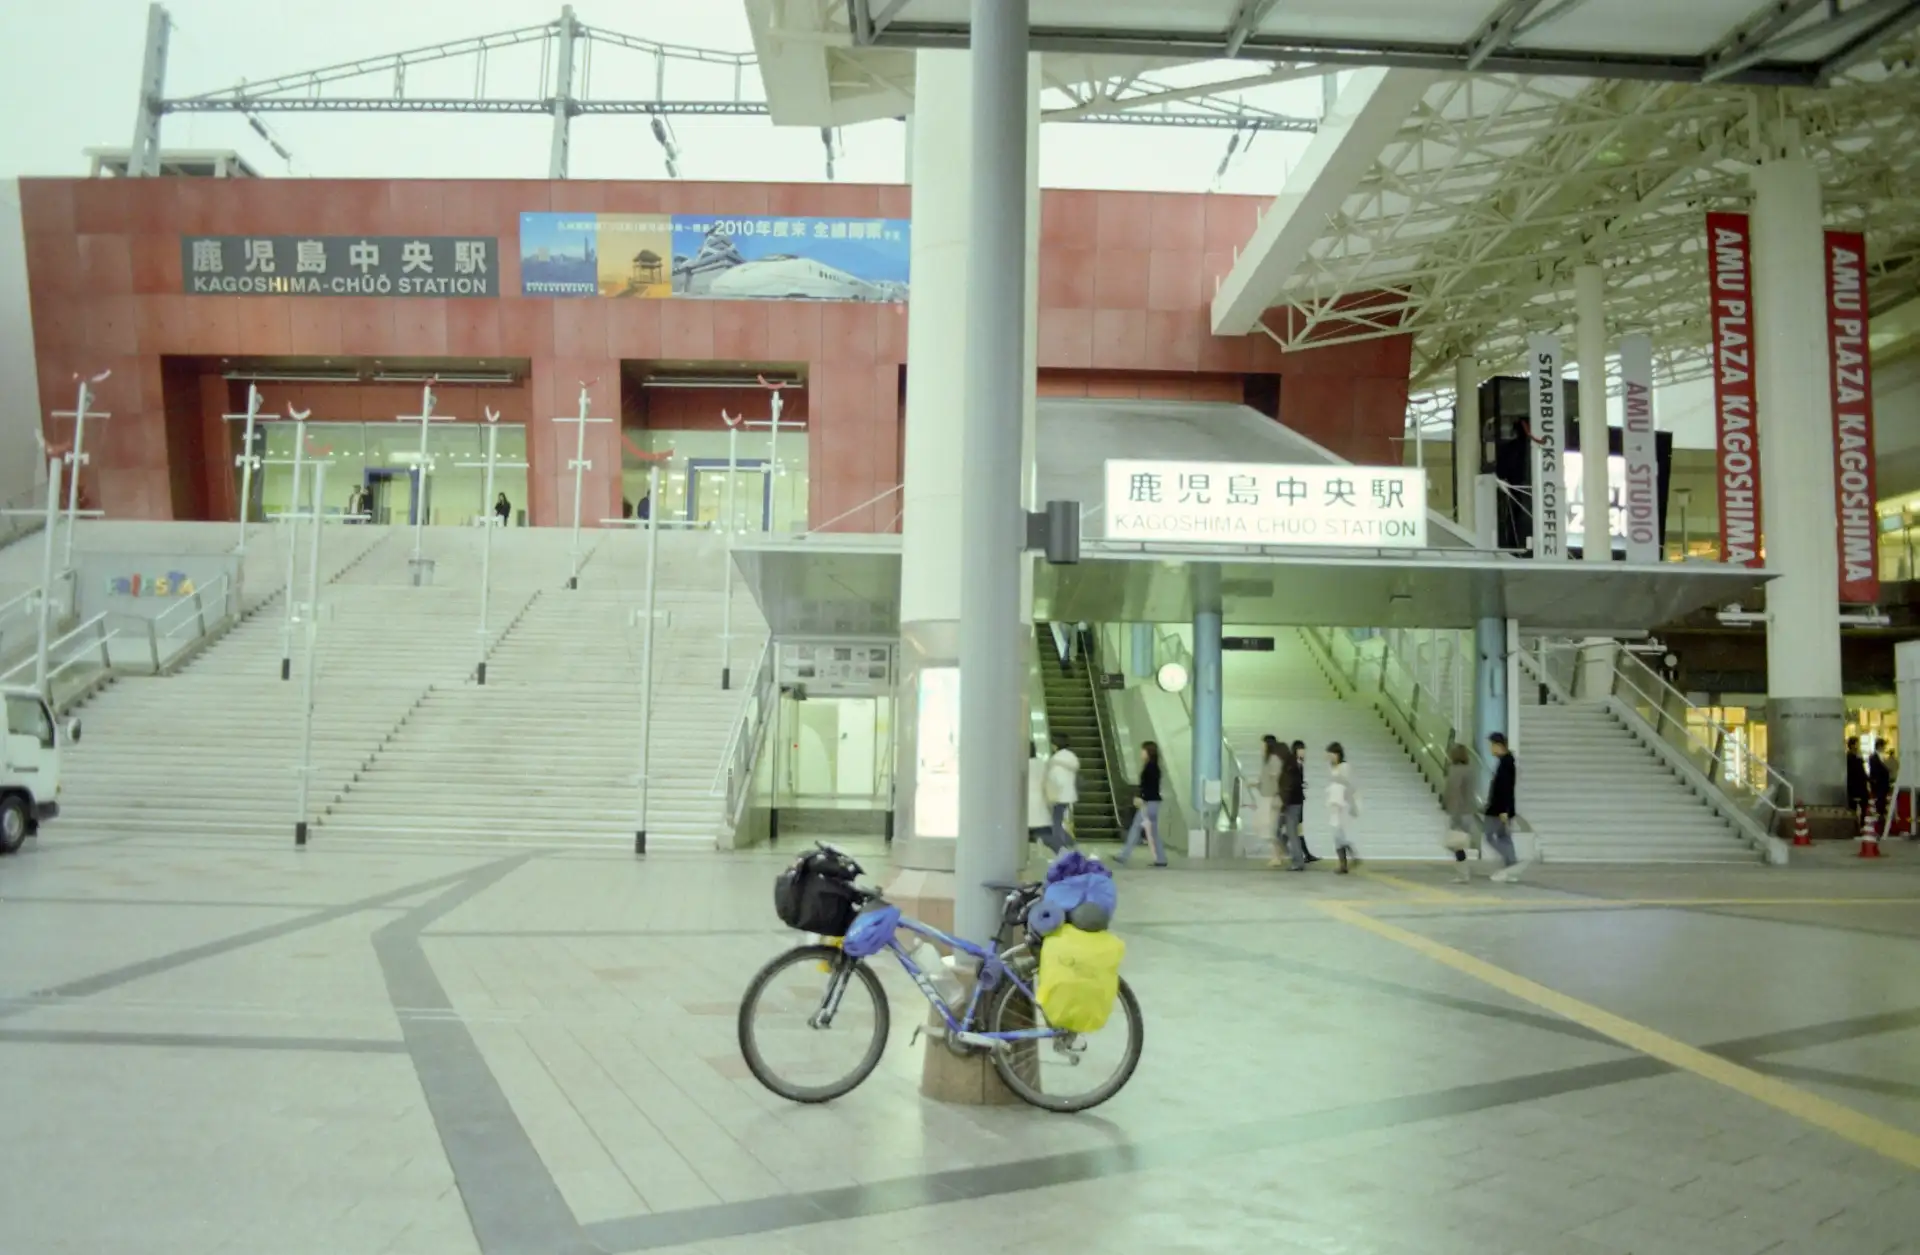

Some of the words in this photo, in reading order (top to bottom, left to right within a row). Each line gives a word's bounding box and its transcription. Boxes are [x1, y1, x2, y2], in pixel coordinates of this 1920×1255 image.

[192, 239, 488, 273] 鹿児島中央駅
[398, 276, 487, 293] STATION
[1714, 228, 1745, 291] AMU
[1832, 246, 1861, 312] AMU
[1718, 300, 1749, 385] PLAZA
[1834, 319, 1865, 403] PLAZA
[1538, 353, 1556, 473] STARBUCKS
[1626, 381, 1649, 434] AMU
[1129, 472, 1404, 509] 鹿児島中央駅
[1629, 464, 1653, 544] STUDIO
[1722, 395, 1756, 564] KAGOSHIMA
[1838, 414, 1872, 581] KAGOSHIMA
[1114, 513, 1247, 534] KAGOSHIMA
[1325, 518, 1417, 537] STATION
